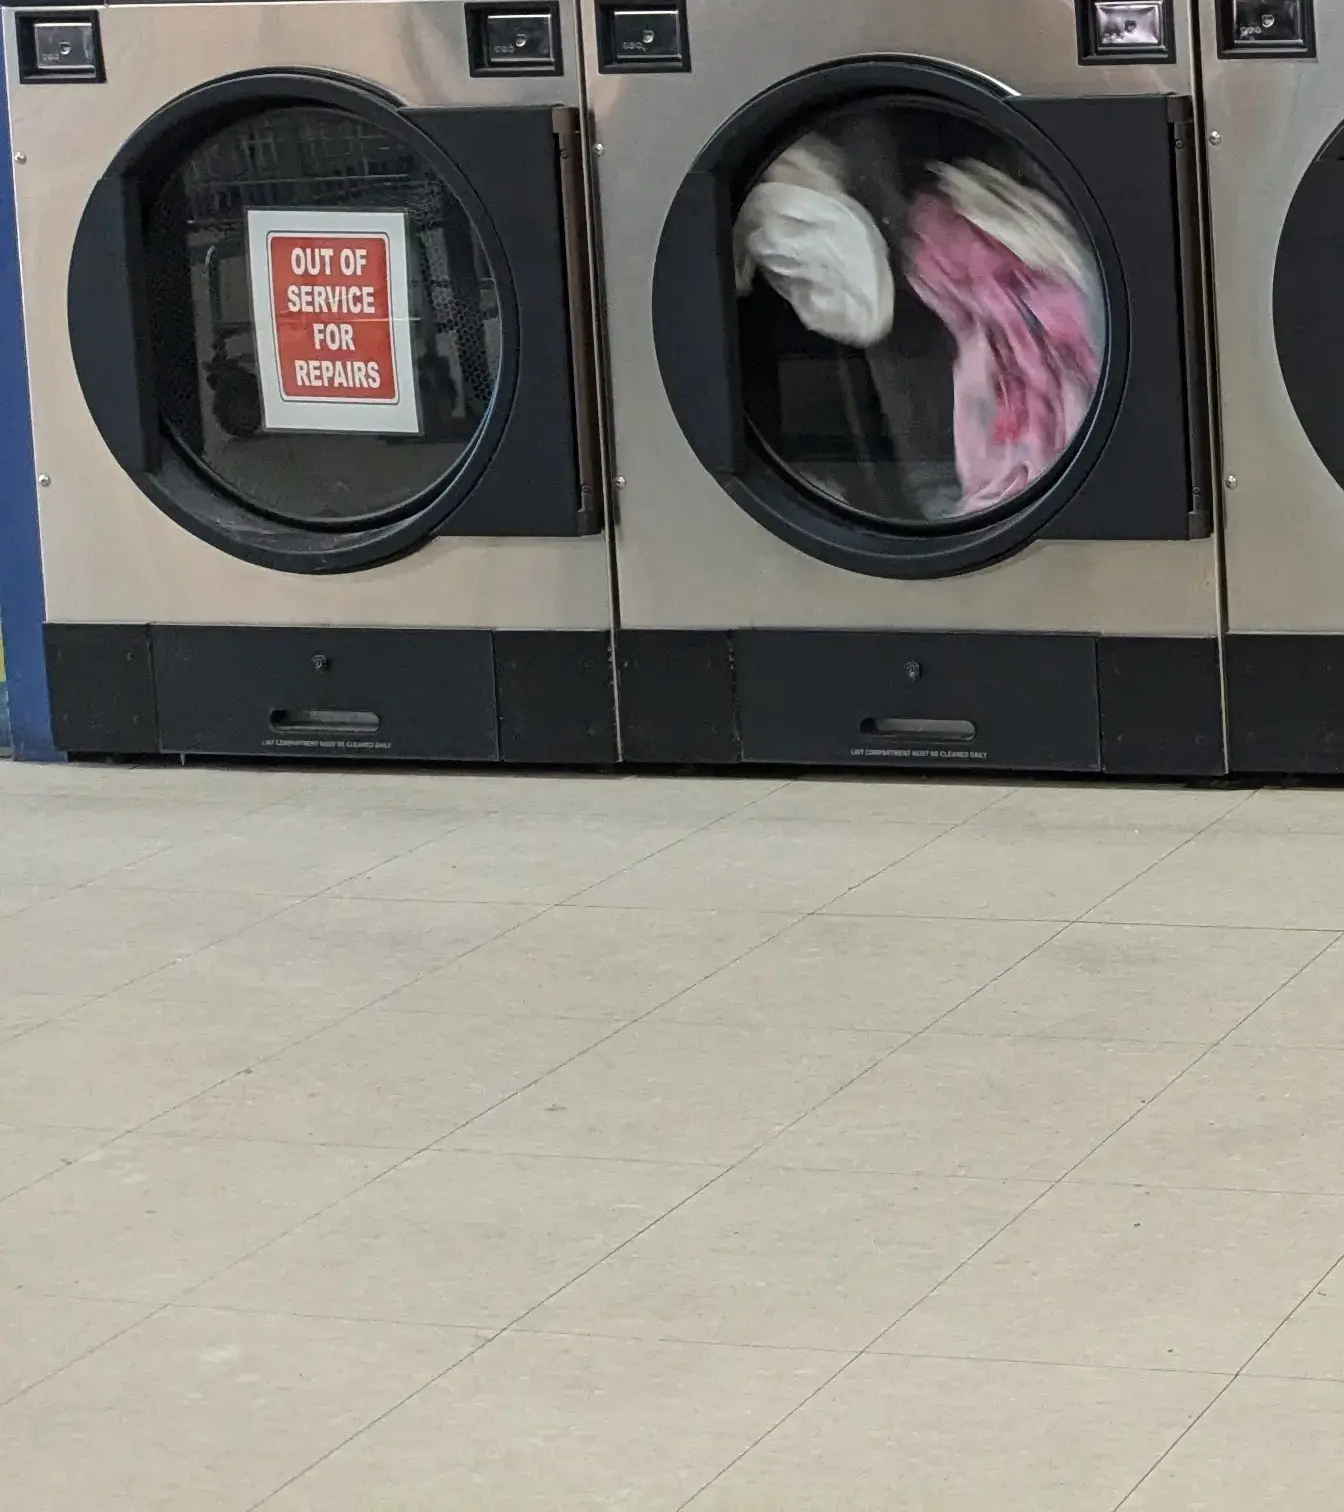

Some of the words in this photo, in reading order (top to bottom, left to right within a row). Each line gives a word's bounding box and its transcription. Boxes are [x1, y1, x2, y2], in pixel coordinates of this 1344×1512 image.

[291, 247, 334, 275] OUT
[340, 249, 367, 275] OF
[287, 285, 375, 313] SERVICE
[313, 324, 355, 350] FOR
[295, 360, 380, 388] REPAIRS
